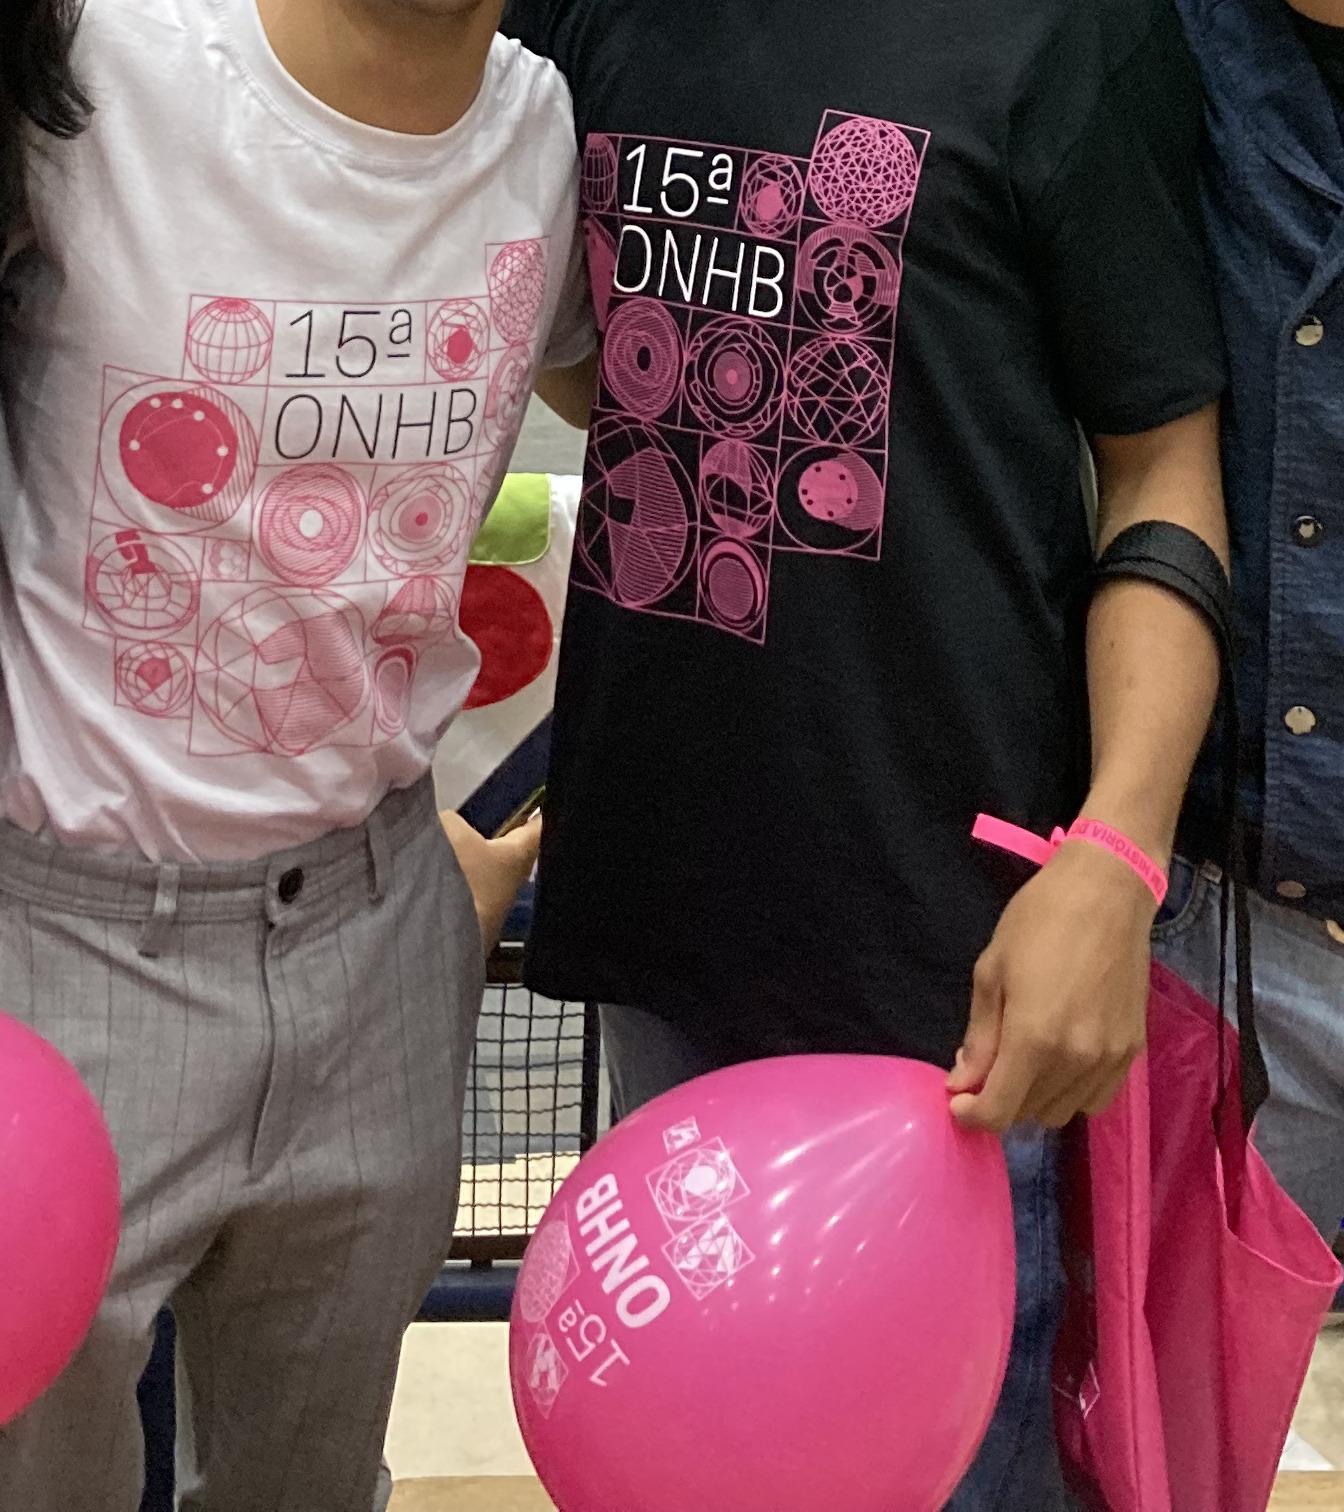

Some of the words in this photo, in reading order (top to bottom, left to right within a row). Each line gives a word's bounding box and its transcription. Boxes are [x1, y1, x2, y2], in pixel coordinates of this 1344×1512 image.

[622, 143, 732, 217] 15ª
[612, 224, 787, 319] ONHB
[285, 308, 412, 378] 15ª
[274, 388, 477, 460] ONHB
[1093, 825, 1152, 876] HISTÓRIA
[576, 1172, 671, 1329] ONHB
[557, 1298, 630, 1388] 15ª
